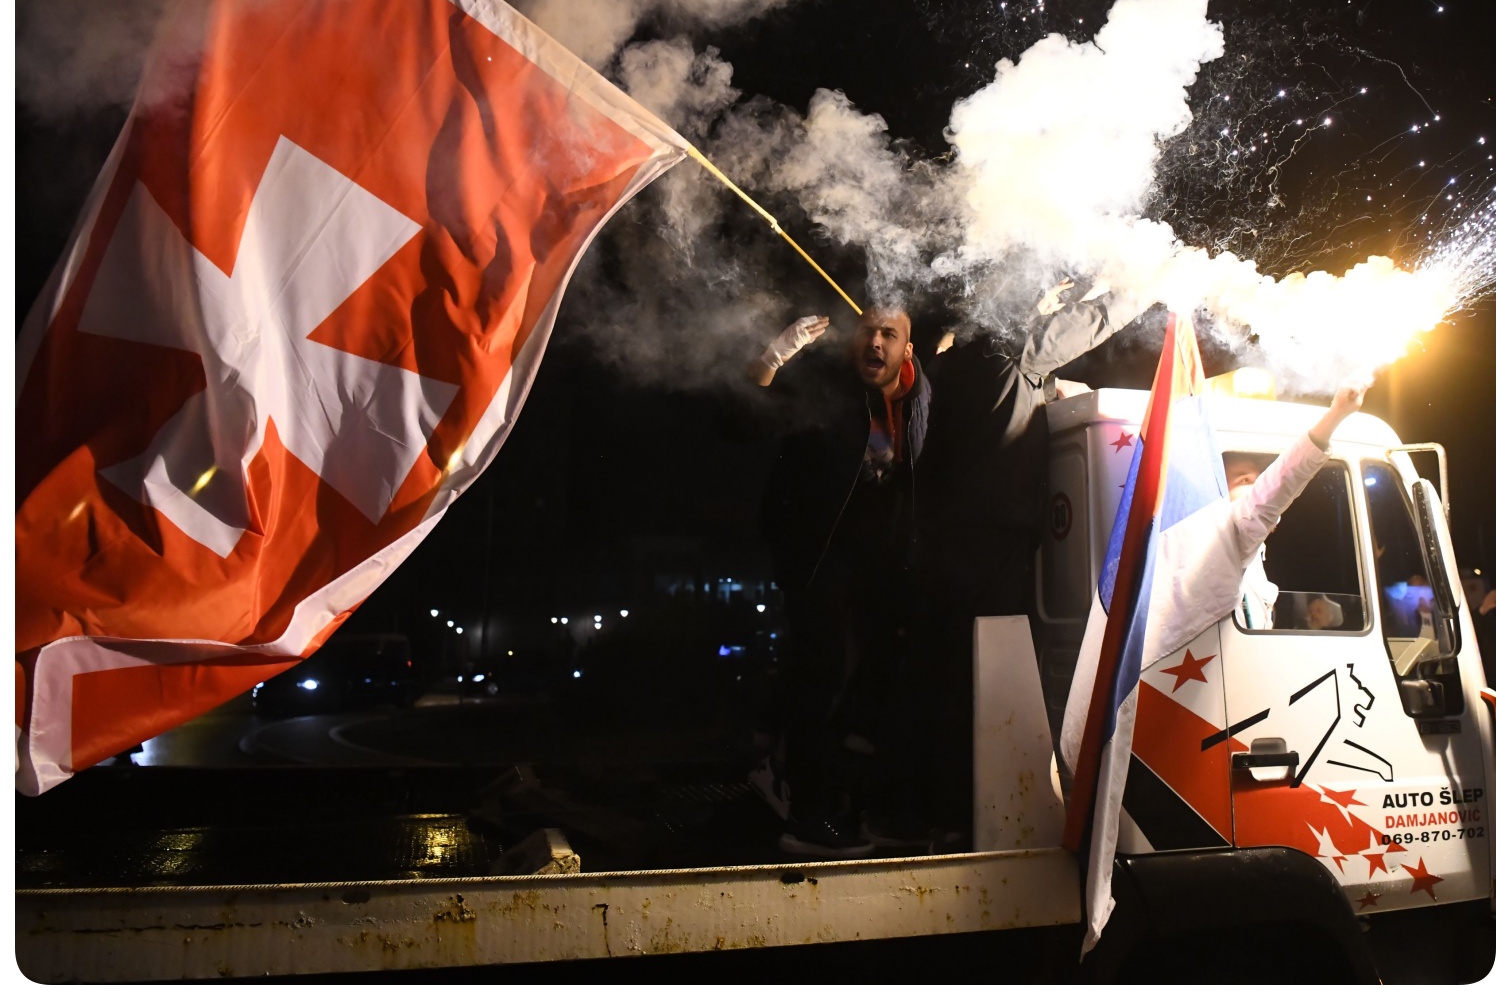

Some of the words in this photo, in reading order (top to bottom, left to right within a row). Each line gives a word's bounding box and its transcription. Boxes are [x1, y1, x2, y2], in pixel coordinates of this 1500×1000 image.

[1382, 791, 1434, 809] AUTO
[1439, 787, 1484, 806] ŠLEP
[1385, 806, 1481, 829] DAMJANOVIĆ
[1381, 826, 1485, 846] 069-870-702
